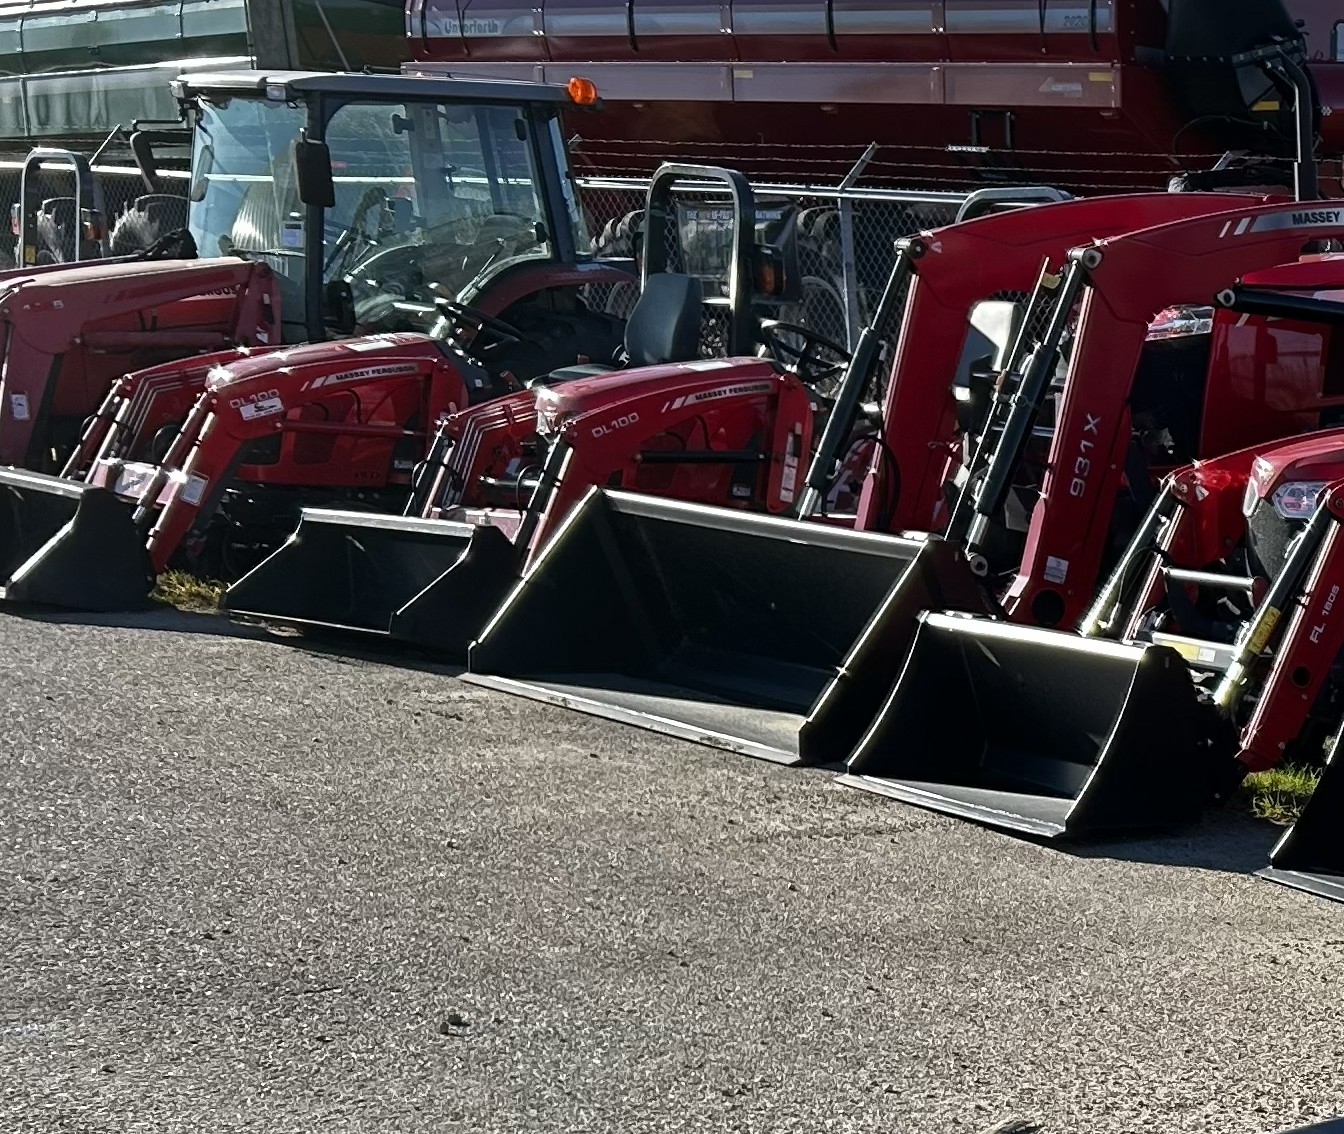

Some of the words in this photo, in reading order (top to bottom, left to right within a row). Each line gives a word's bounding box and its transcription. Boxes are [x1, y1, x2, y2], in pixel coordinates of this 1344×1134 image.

[444, 20, 498, 34] Unerferth
[1292, 211, 1340, 225] MASSEY
[336, 369, 370, 381] MASSEY
[371, 365, 415, 376] FERGUSON
[695, 389, 727, 401] MASSEY
[592, 412, 640, 438] DL100
[1070, 412, 1102, 498] 931X
[1309, 623, 1326, 644] FL
